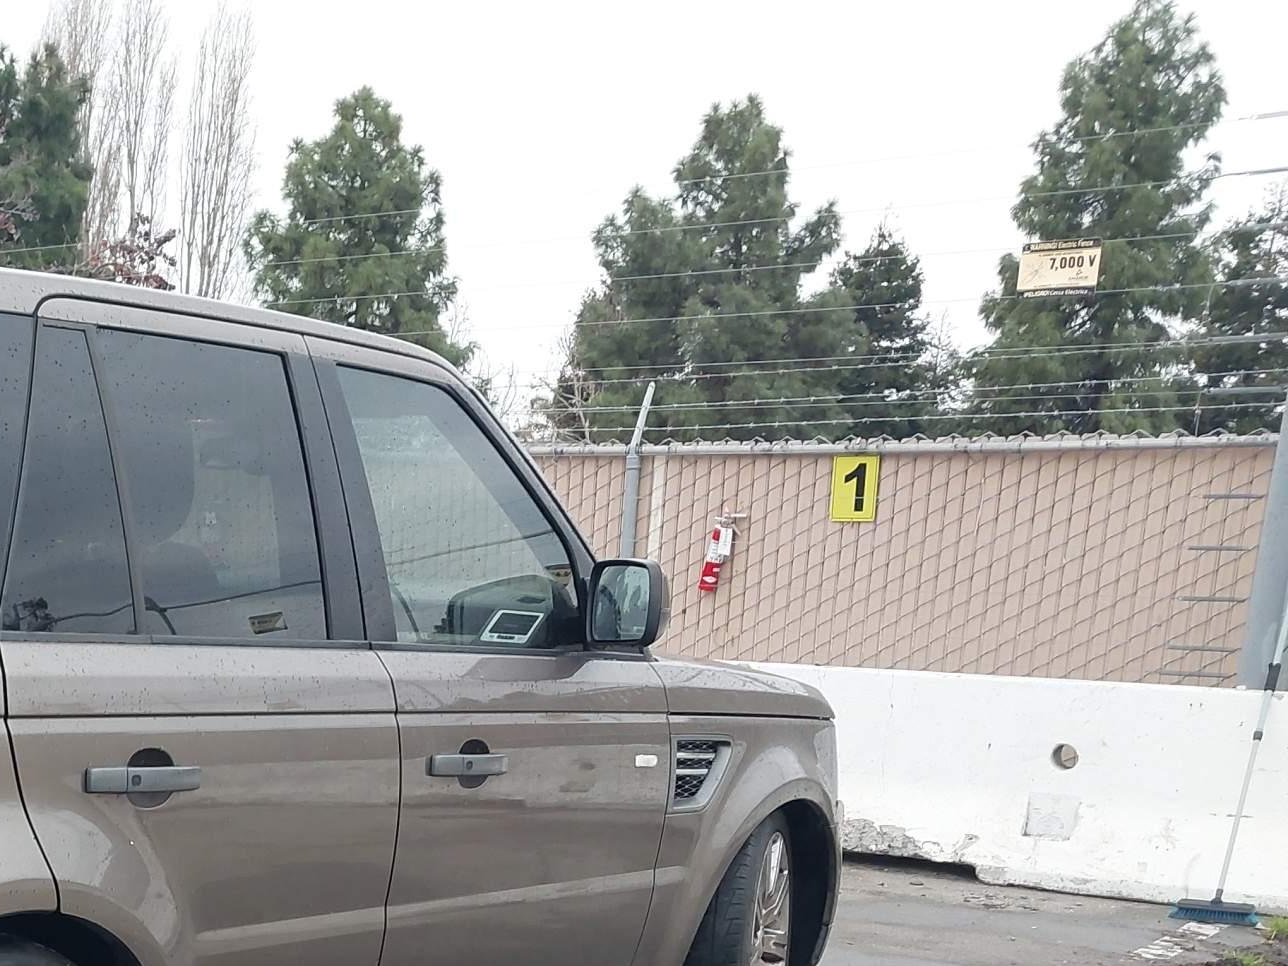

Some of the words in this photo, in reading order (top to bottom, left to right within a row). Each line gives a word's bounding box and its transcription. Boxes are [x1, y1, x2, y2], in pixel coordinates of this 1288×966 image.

[1049, 255, 1084, 271] 7,000
[1089, 254, 1097, 267] V
[844, 462, 867, 512] 1
